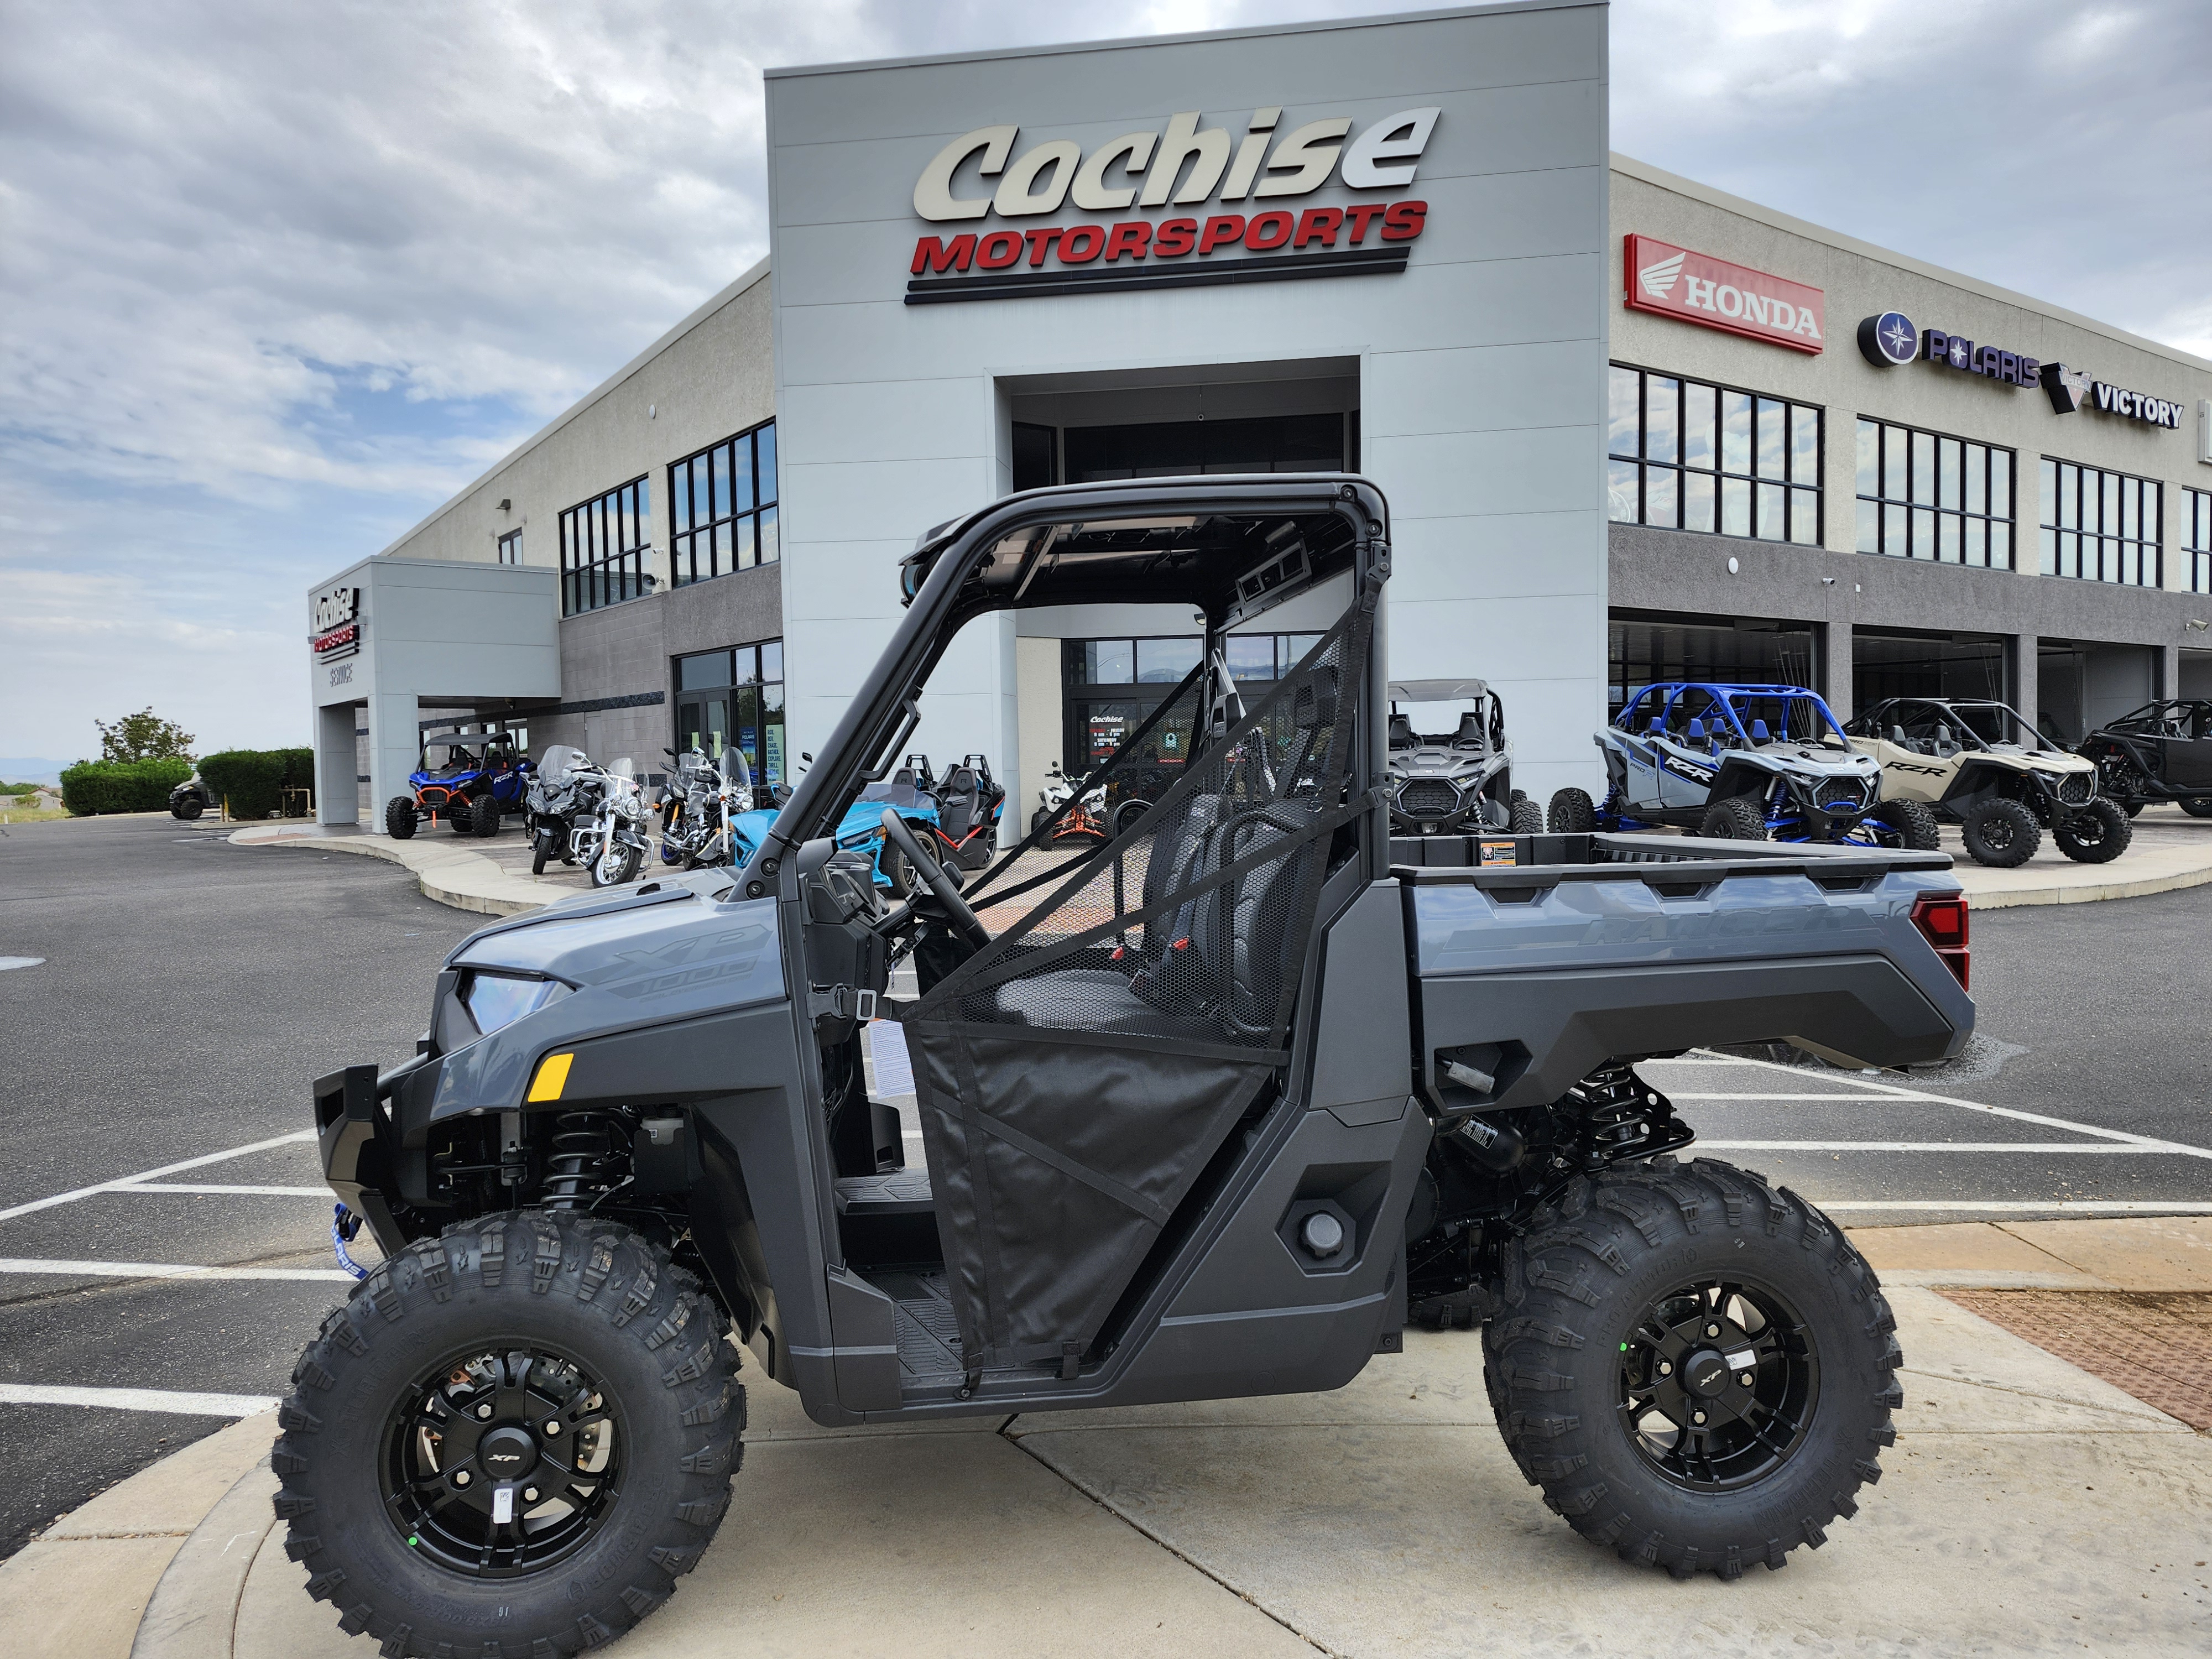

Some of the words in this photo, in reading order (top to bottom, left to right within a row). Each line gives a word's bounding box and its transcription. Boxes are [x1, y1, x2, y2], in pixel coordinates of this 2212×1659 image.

[914, 106, 1441, 221] Cochise
[910, 201, 1427, 274] MOTORSPORTS
[1685, 274, 1822, 340] HONDA
[1923, 328, 2039, 388] POLARIS
[2061, 375, 2090, 389] VICTORY
[2094, 382, 2184, 429] VICTORY
[314, 588, 357, 633] Cochise
[314, 625, 356, 653] MOTORSPORTS
[330, 663, 353, 687] SERVICE
[494, 771, 513, 785] RZR
[1630, 763, 1646, 773] PRO
[1642, 769, 1655, 780] R
[1665, 756, 1714, 782] RZR
[1884, 761, 1948, 778] RZR
[1578, 906, 1851, 945] RANGER
[594, 924, 774, 985] XP
[641, 955, 760, 994] 1000
[1700, 1369, 1722, 1387] XP
